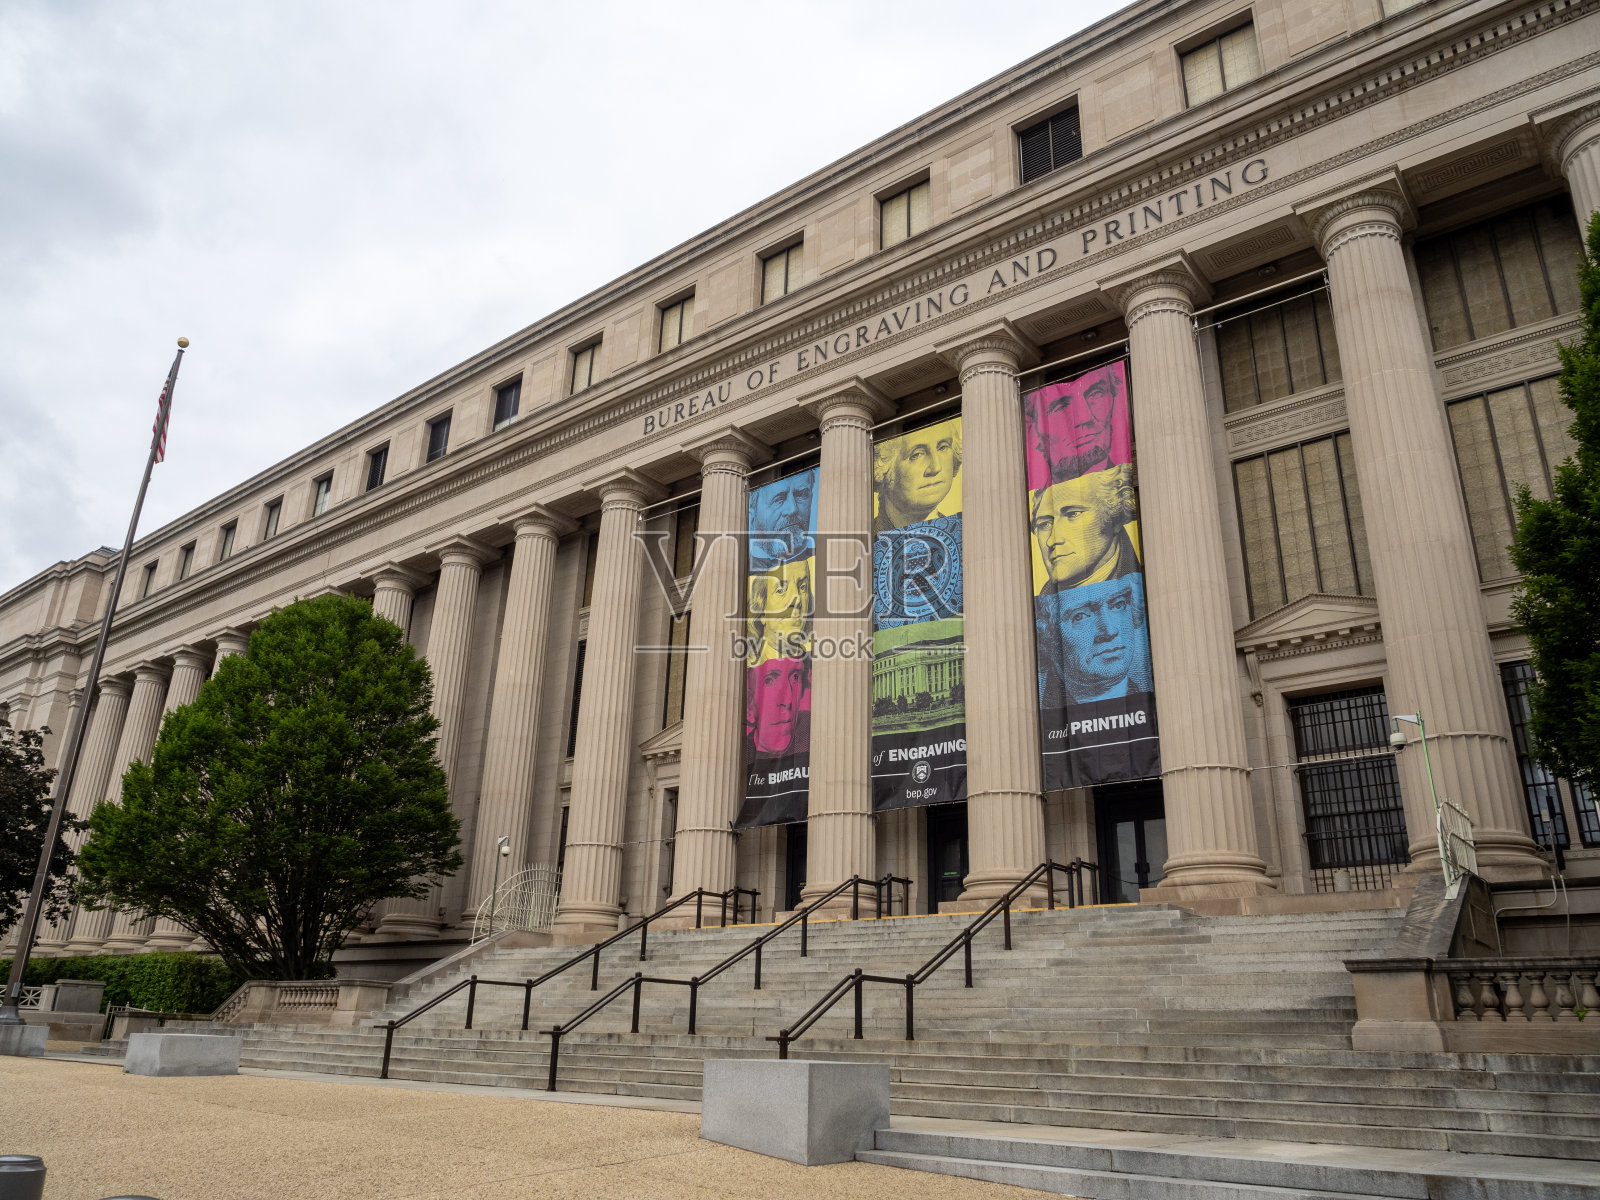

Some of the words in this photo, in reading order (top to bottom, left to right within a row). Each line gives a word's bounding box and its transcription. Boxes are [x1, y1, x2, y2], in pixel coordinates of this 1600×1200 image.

[642, 381, 733, 436] BUREAU
[746, 361, 781, 391] OF
[796, 283, 970, 372] ENGRAVING
[986, 248, 1058, 294] AND
[1081, 158, 1268, 255] PRINTING
[1048, 723, 1069, 740] and
[1070, 710, 1147, 736] PRINTING
[873, 750, 886, 767] of
[888, 739, 967, 762] ENGRAVING
[748, 773, 766, 786] The
[768, 766, 810, 785] BUREAU
[906, 787, 938, 800] bep.gov
